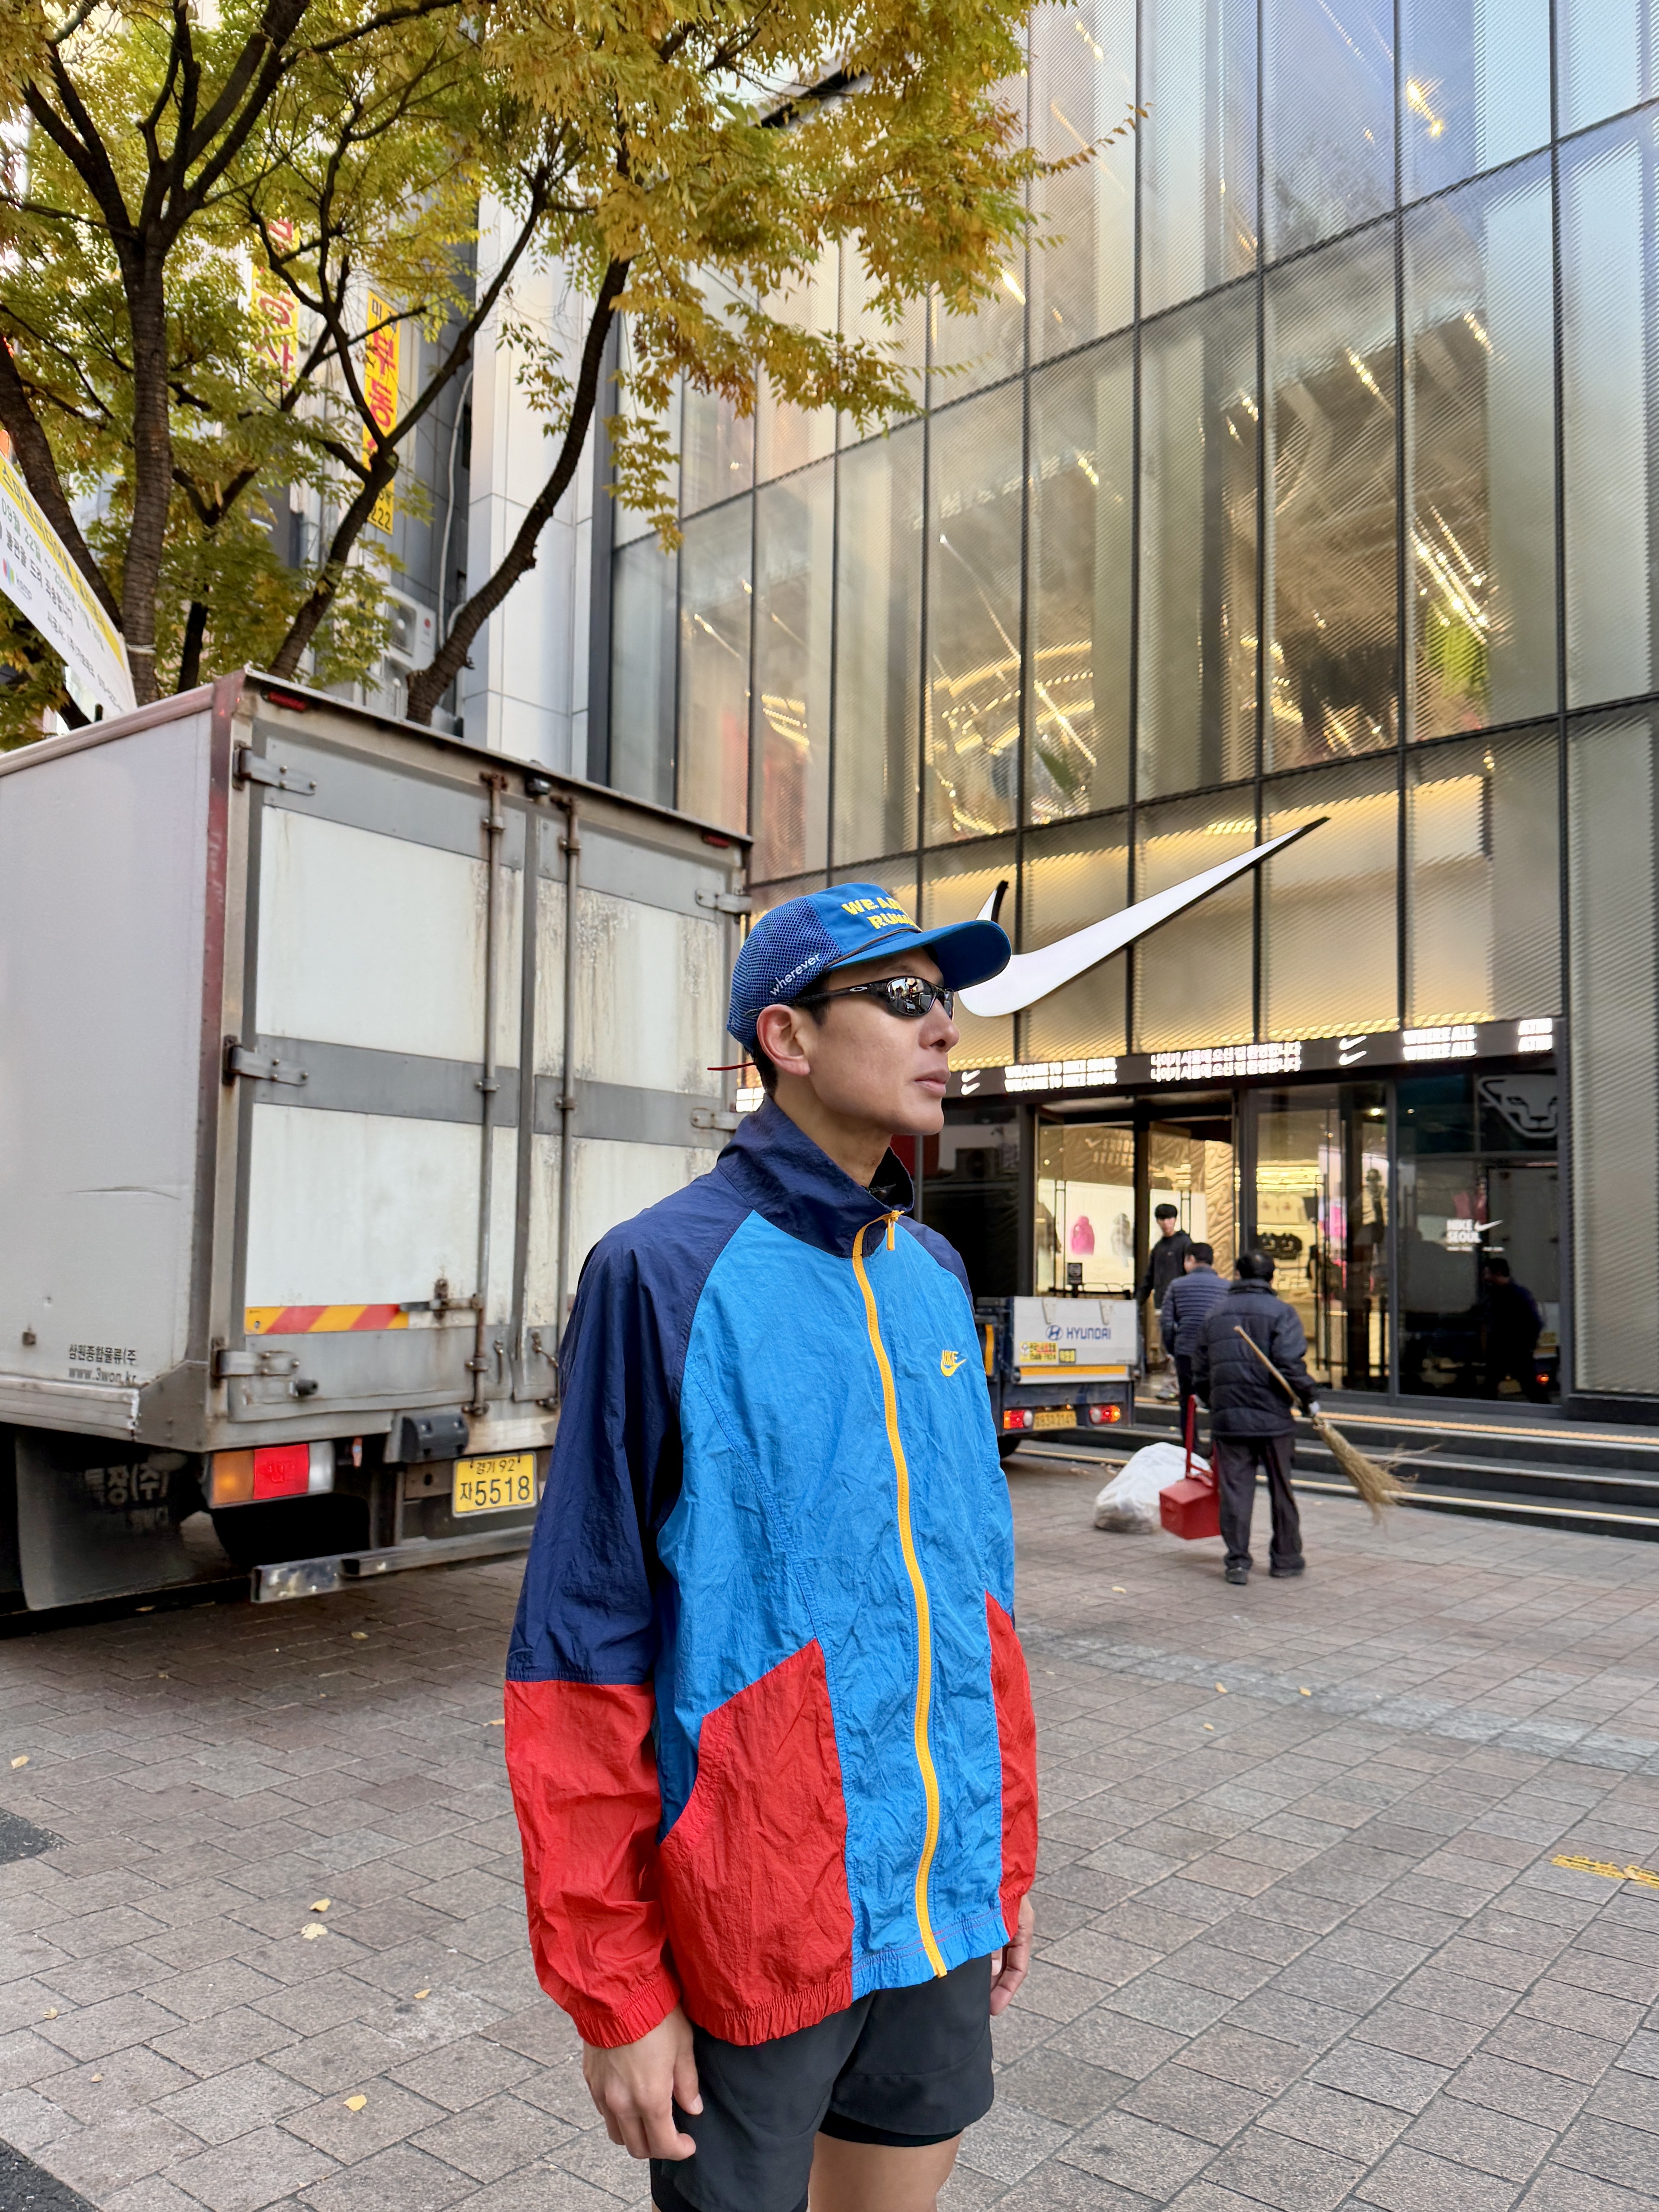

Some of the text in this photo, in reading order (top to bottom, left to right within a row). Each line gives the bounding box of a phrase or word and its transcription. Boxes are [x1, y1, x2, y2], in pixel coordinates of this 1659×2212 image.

[367, 330, 395, 450] 부동
[841, 899, 879, 915] WE
[770, 953, 821, 996] wherever
[1403, 1026, 1451, 1045] WHERE
[1451, 1025, 1477, 1041] ALL
[1403, 1043, 1451, 1061] WHERE
[1451, 1041, 1477, 1057] ALL
[1066, 1327, 1111, 1340] HYUNDAI
[477, 1458, 515, 1475] 경기 92
